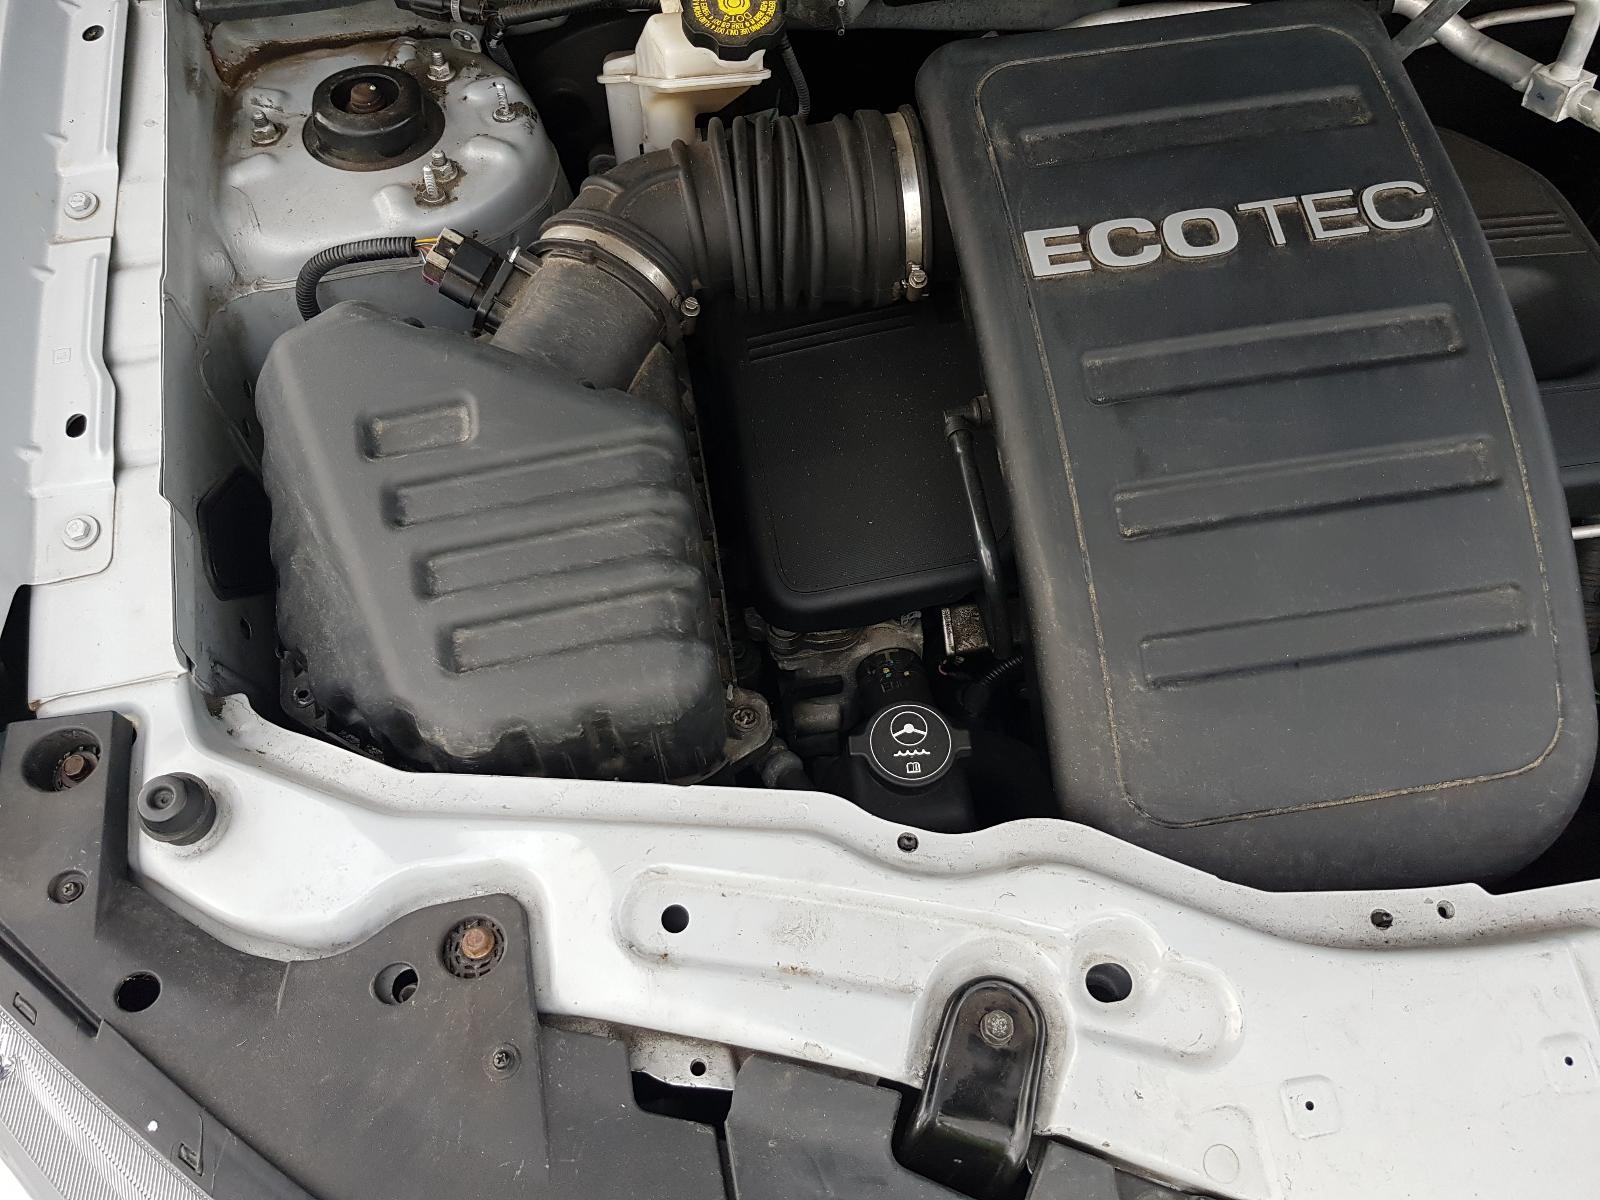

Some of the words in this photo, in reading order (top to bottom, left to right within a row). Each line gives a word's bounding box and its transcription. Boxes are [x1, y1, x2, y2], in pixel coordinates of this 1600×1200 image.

[699, 16, 712, 28] FLUID
[714, 26, 725, 35] DOT
[739, 28, 751, 36] USE
[1022, 180, 1436, 280] ECOTEC
